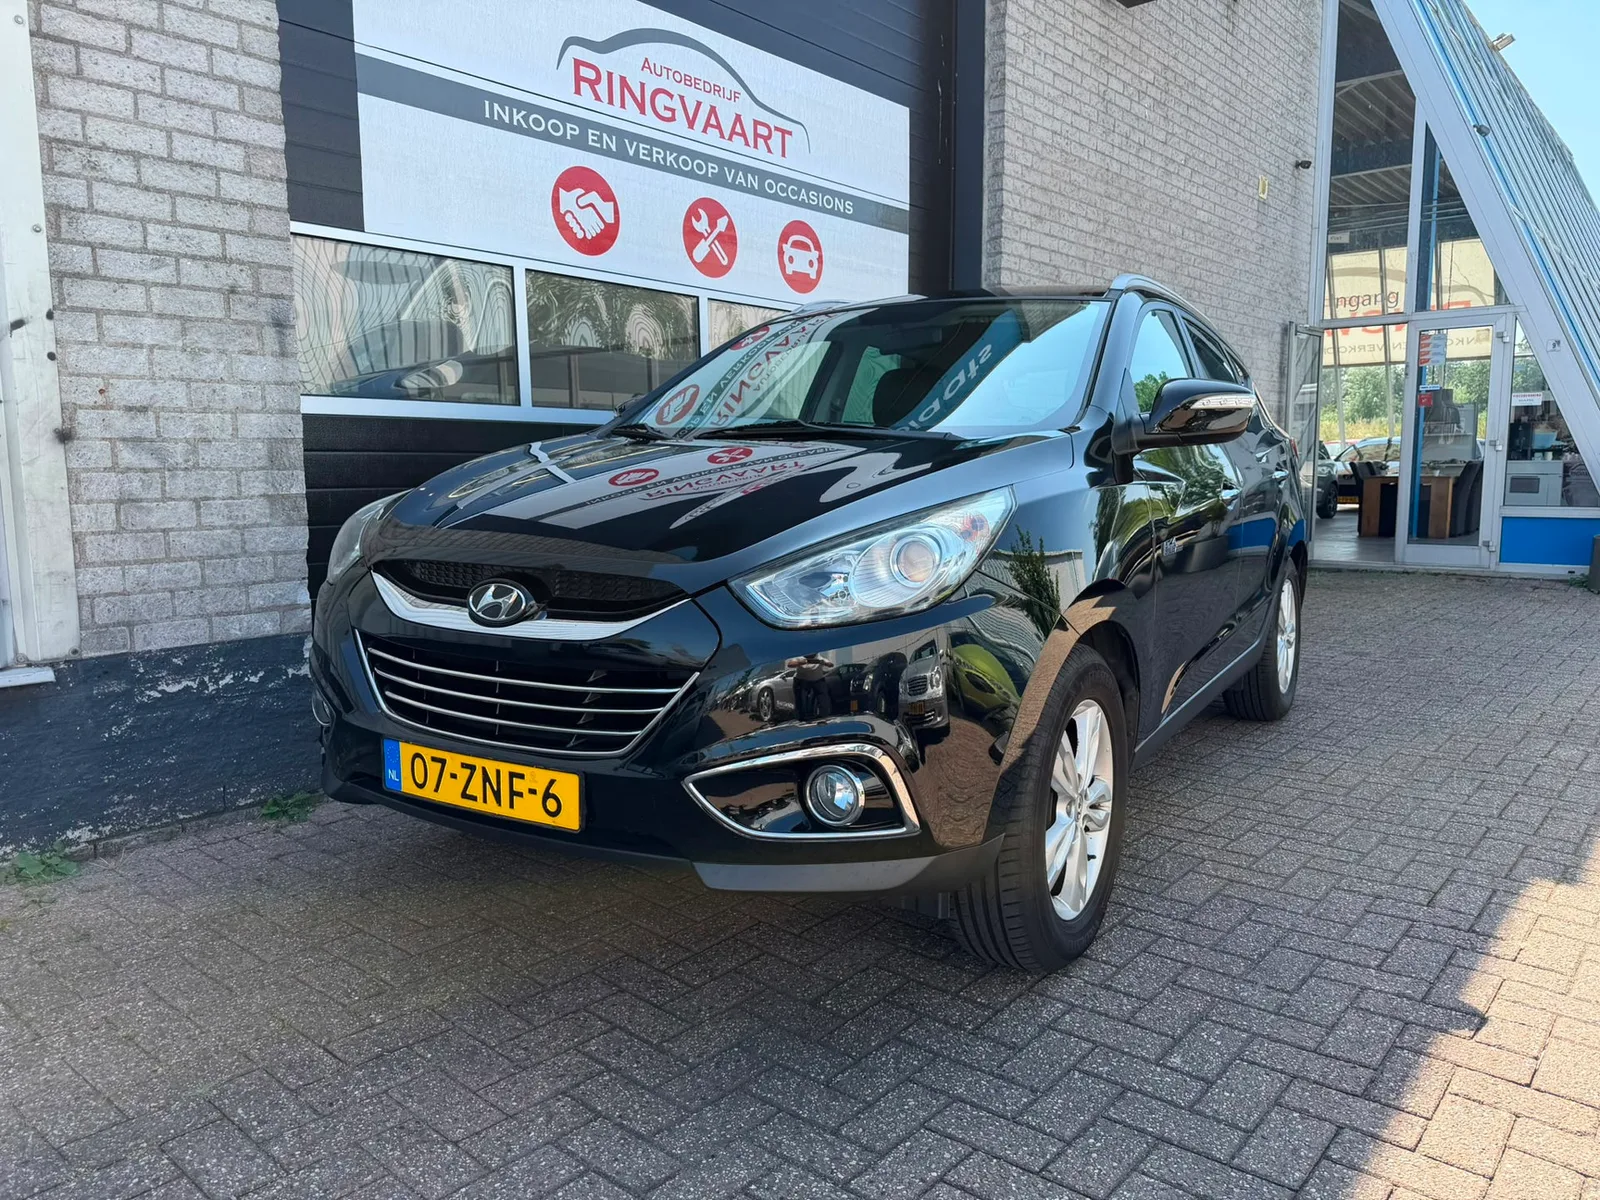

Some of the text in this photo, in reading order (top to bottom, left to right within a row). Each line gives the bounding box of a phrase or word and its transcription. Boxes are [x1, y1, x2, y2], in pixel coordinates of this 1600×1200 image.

[572, 57, 793, 158] RINGVAART
[641, 57, 741, 103] AUTOBEDRIJF
[483, 100, 854, 215] INKOOP EN VERKOOP VAN OCCASIONS
[1333, 291, 1399, 312] ngang
[388, 769, 399, 782] NL
[410, 752, 563, 818] 07-ZNF-6
